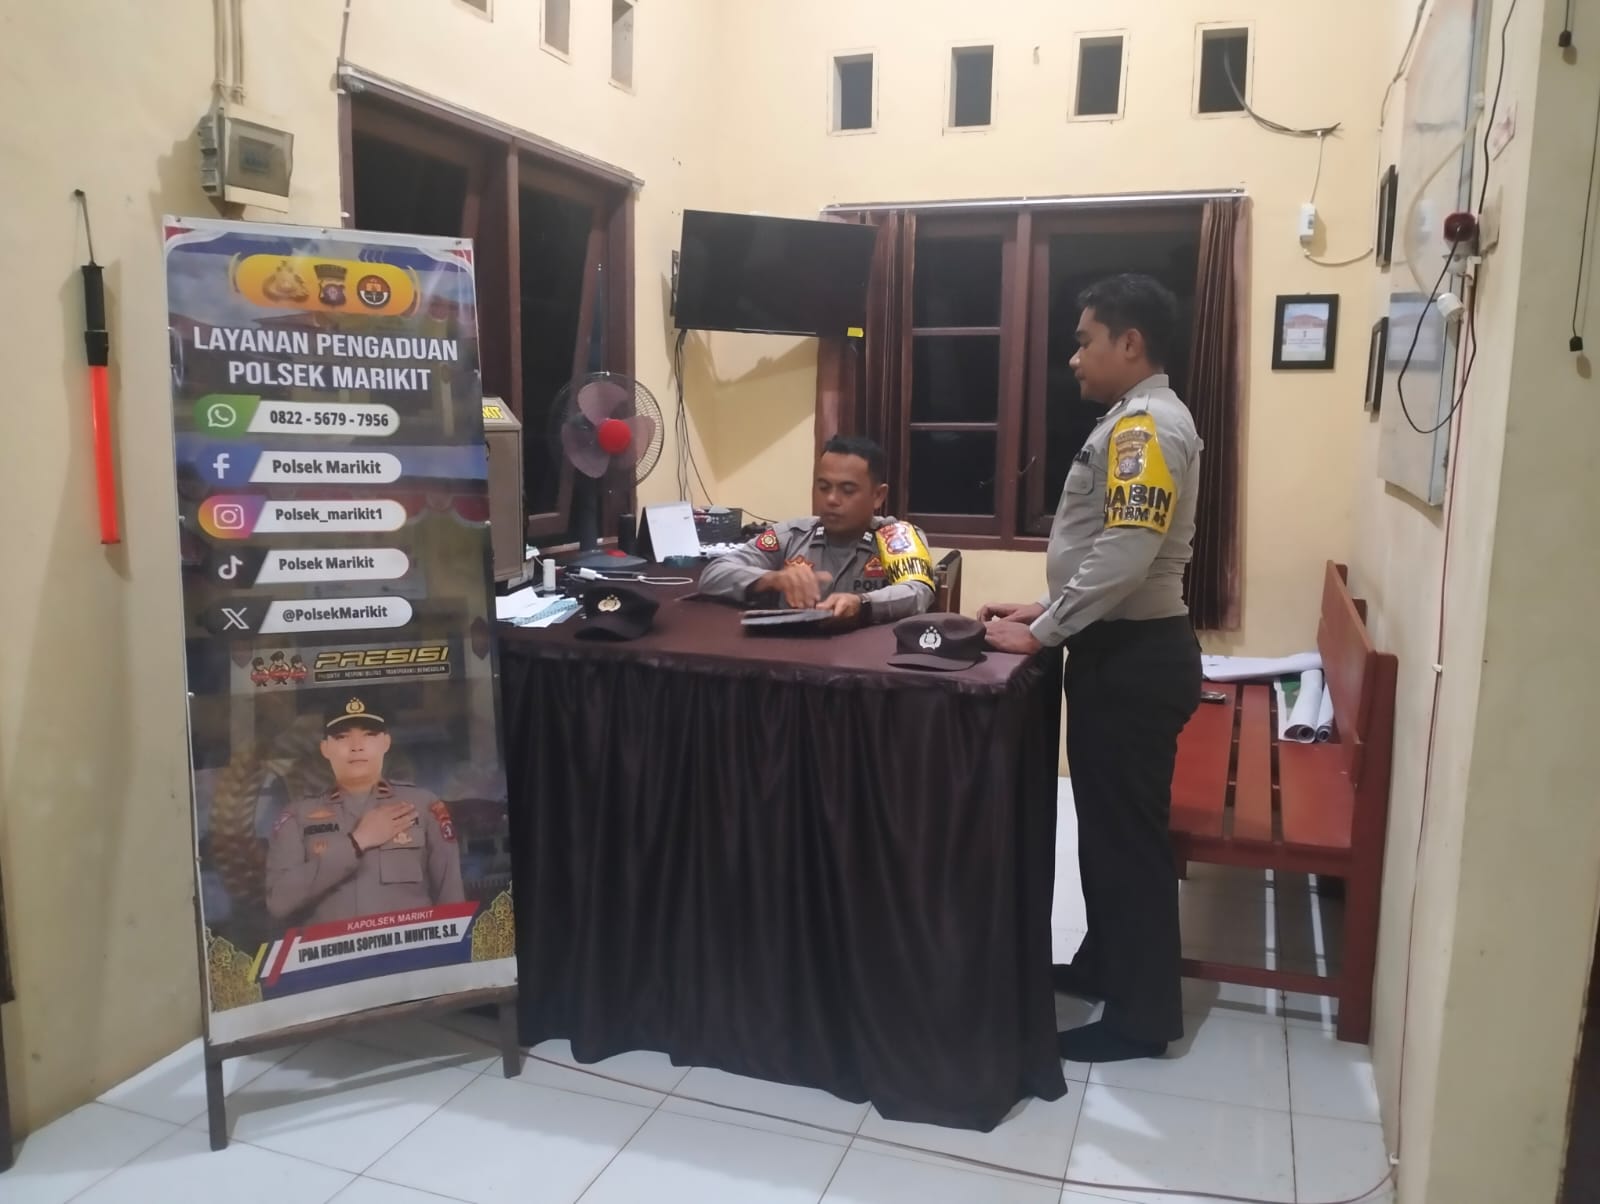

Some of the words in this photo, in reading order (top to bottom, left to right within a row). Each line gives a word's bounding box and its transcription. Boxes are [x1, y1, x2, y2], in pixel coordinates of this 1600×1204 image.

[193, 326, 309, 355] LAYANAN
[317, 334, 458, 361] PENGADUAN
[229, 361, 325, 388] POLSEK
[333, 367, 431, 391] MARIKIT
[269, 410, 303, 425] 0822
[314, 411, 347, 426] 5679
[357, 413, 389, 427] 7956
[272, 459, 323, 474] Polsek
[326, 459, 381, 474] Marikit
[275, 507, 383, 523] Polsek_marikit1
[278, 557, 323, 571] Polsek
[326, 555, 375, 570] Marikit
[282, 605, 388, 623] @PolsekMarikit
[315, 646, 449, 669] PRESISI
[347, 915, 396, 930] KAPOLSEK
[398, 910, 434, 923] MARIKIT
[321, 940, 356, 958] HENDRA
[357, 934, 393, 952] SOPIYAN
